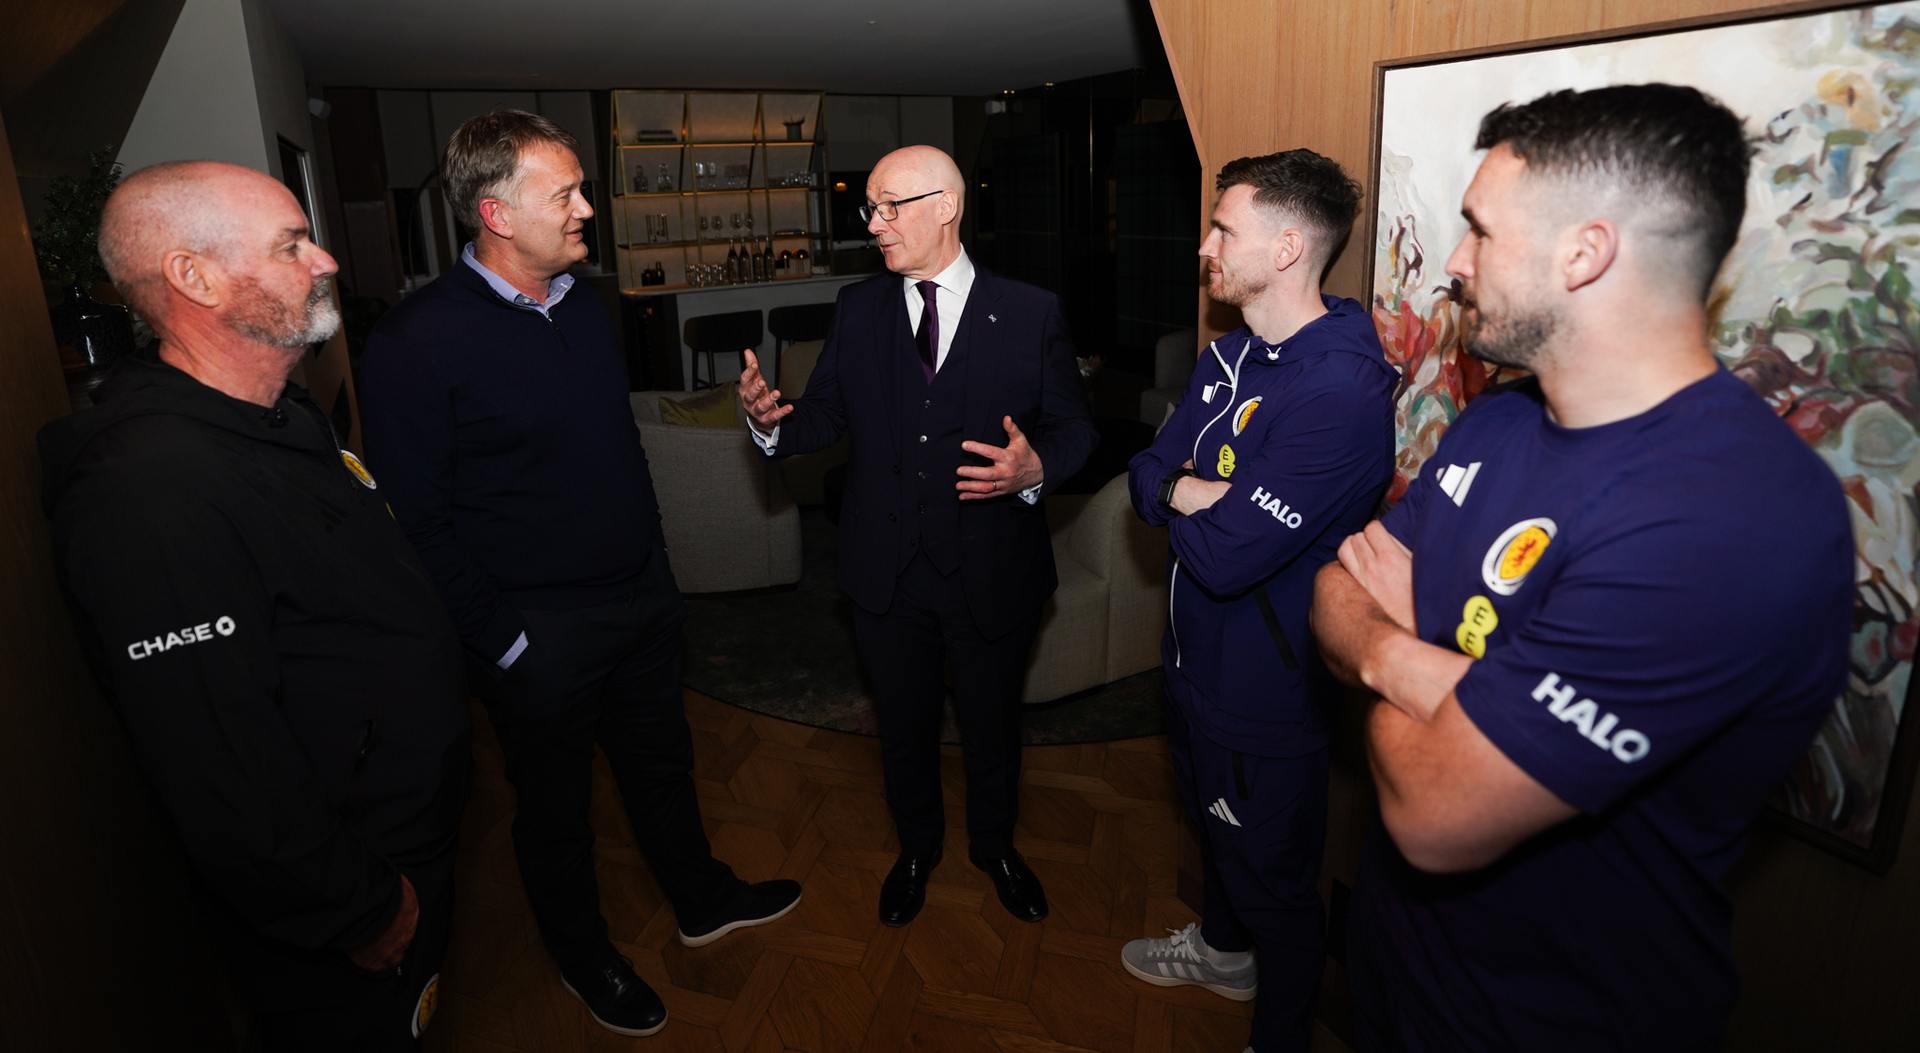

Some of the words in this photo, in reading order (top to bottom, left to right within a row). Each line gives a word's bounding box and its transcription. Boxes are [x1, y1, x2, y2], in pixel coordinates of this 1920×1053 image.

[1250, 486, 1303, 529] HALO
[128, 622, 214, 660] CHASE
[1531, 672, 1651, 764] HALO
